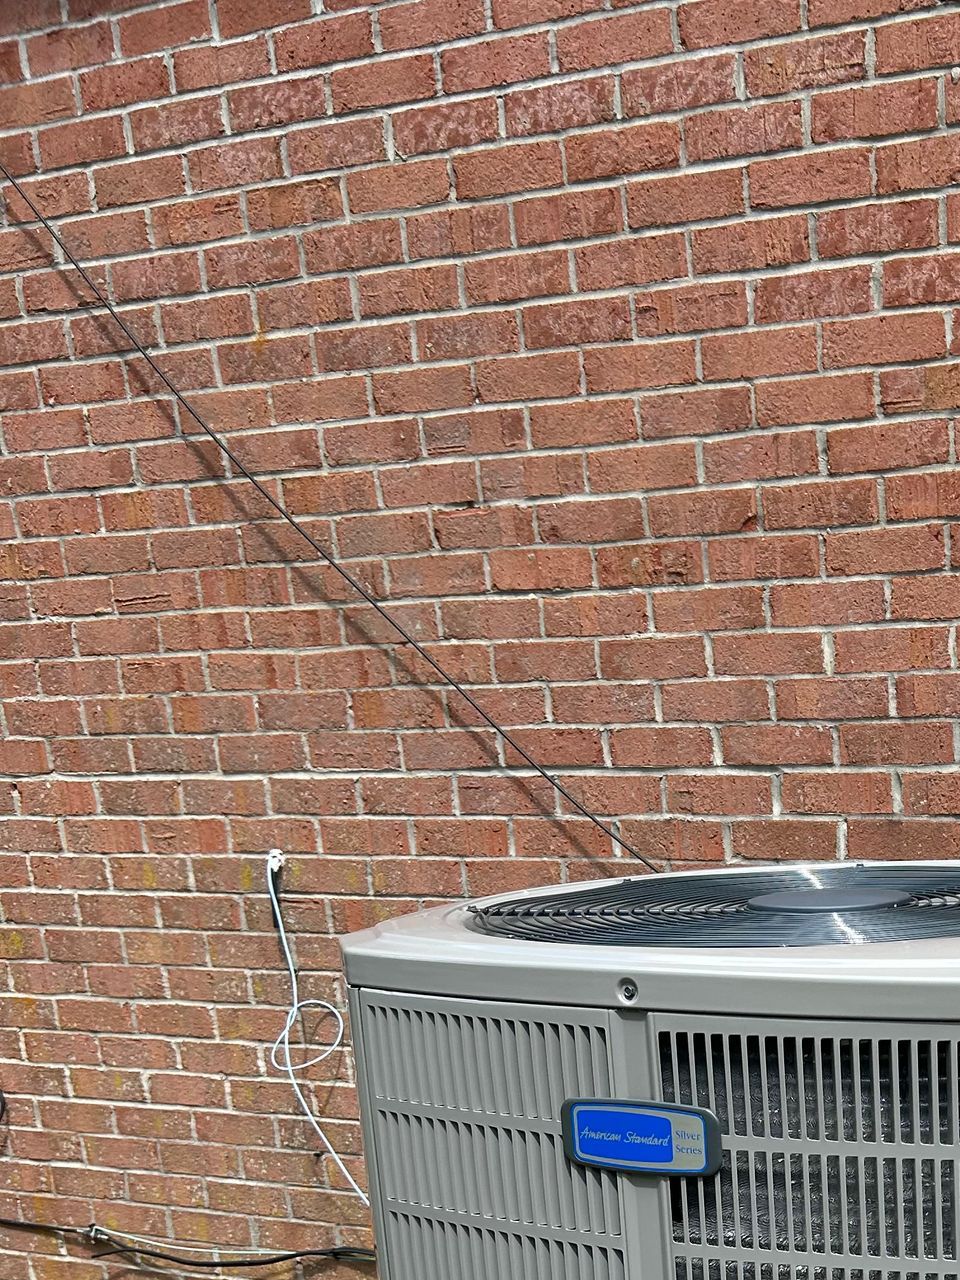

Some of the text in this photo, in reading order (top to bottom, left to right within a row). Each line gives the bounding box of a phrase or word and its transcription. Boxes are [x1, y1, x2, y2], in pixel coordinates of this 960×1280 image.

[580, 1126, 670, 1147] American Standard
[675, 1130, 701, 1141] Silver
[675, 1144, 703, 1155] Series
